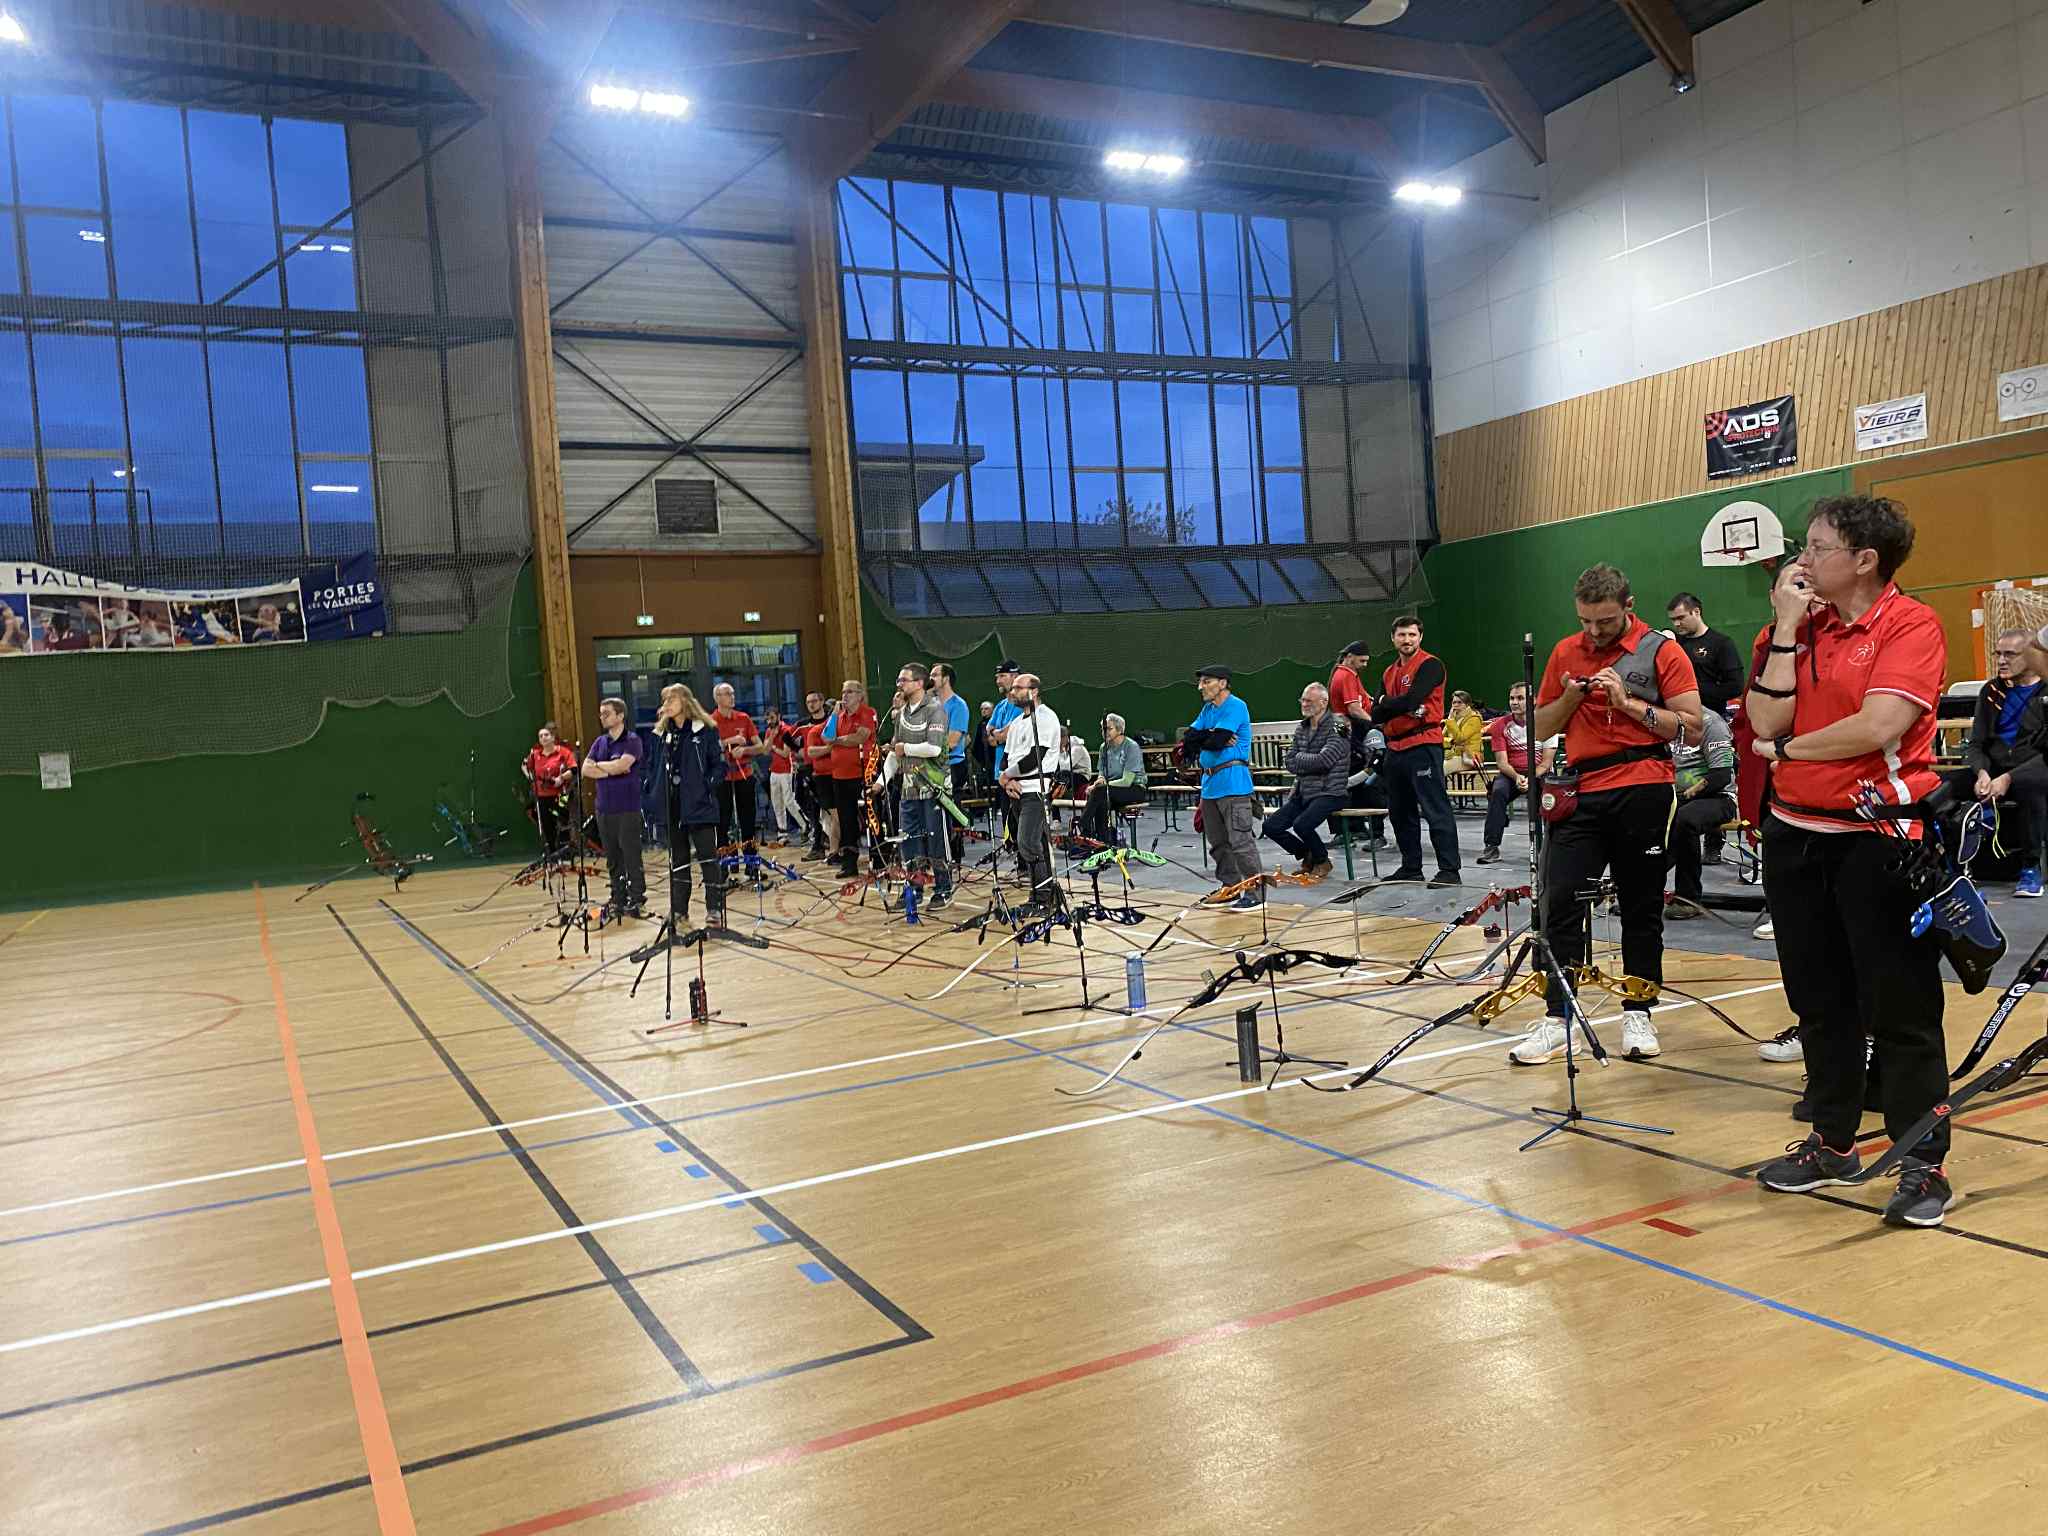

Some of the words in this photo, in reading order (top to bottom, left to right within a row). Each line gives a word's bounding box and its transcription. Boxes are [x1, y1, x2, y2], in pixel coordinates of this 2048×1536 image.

[1723, 409, 1780, 436] ADS
[1858, 407, 1922, 428] VIEIRA
[313, 582, 375, 602] PORTES
[322, 594, 372, 609] VALENCE
[1376, 1022, 1435, 1070] KINETIC
